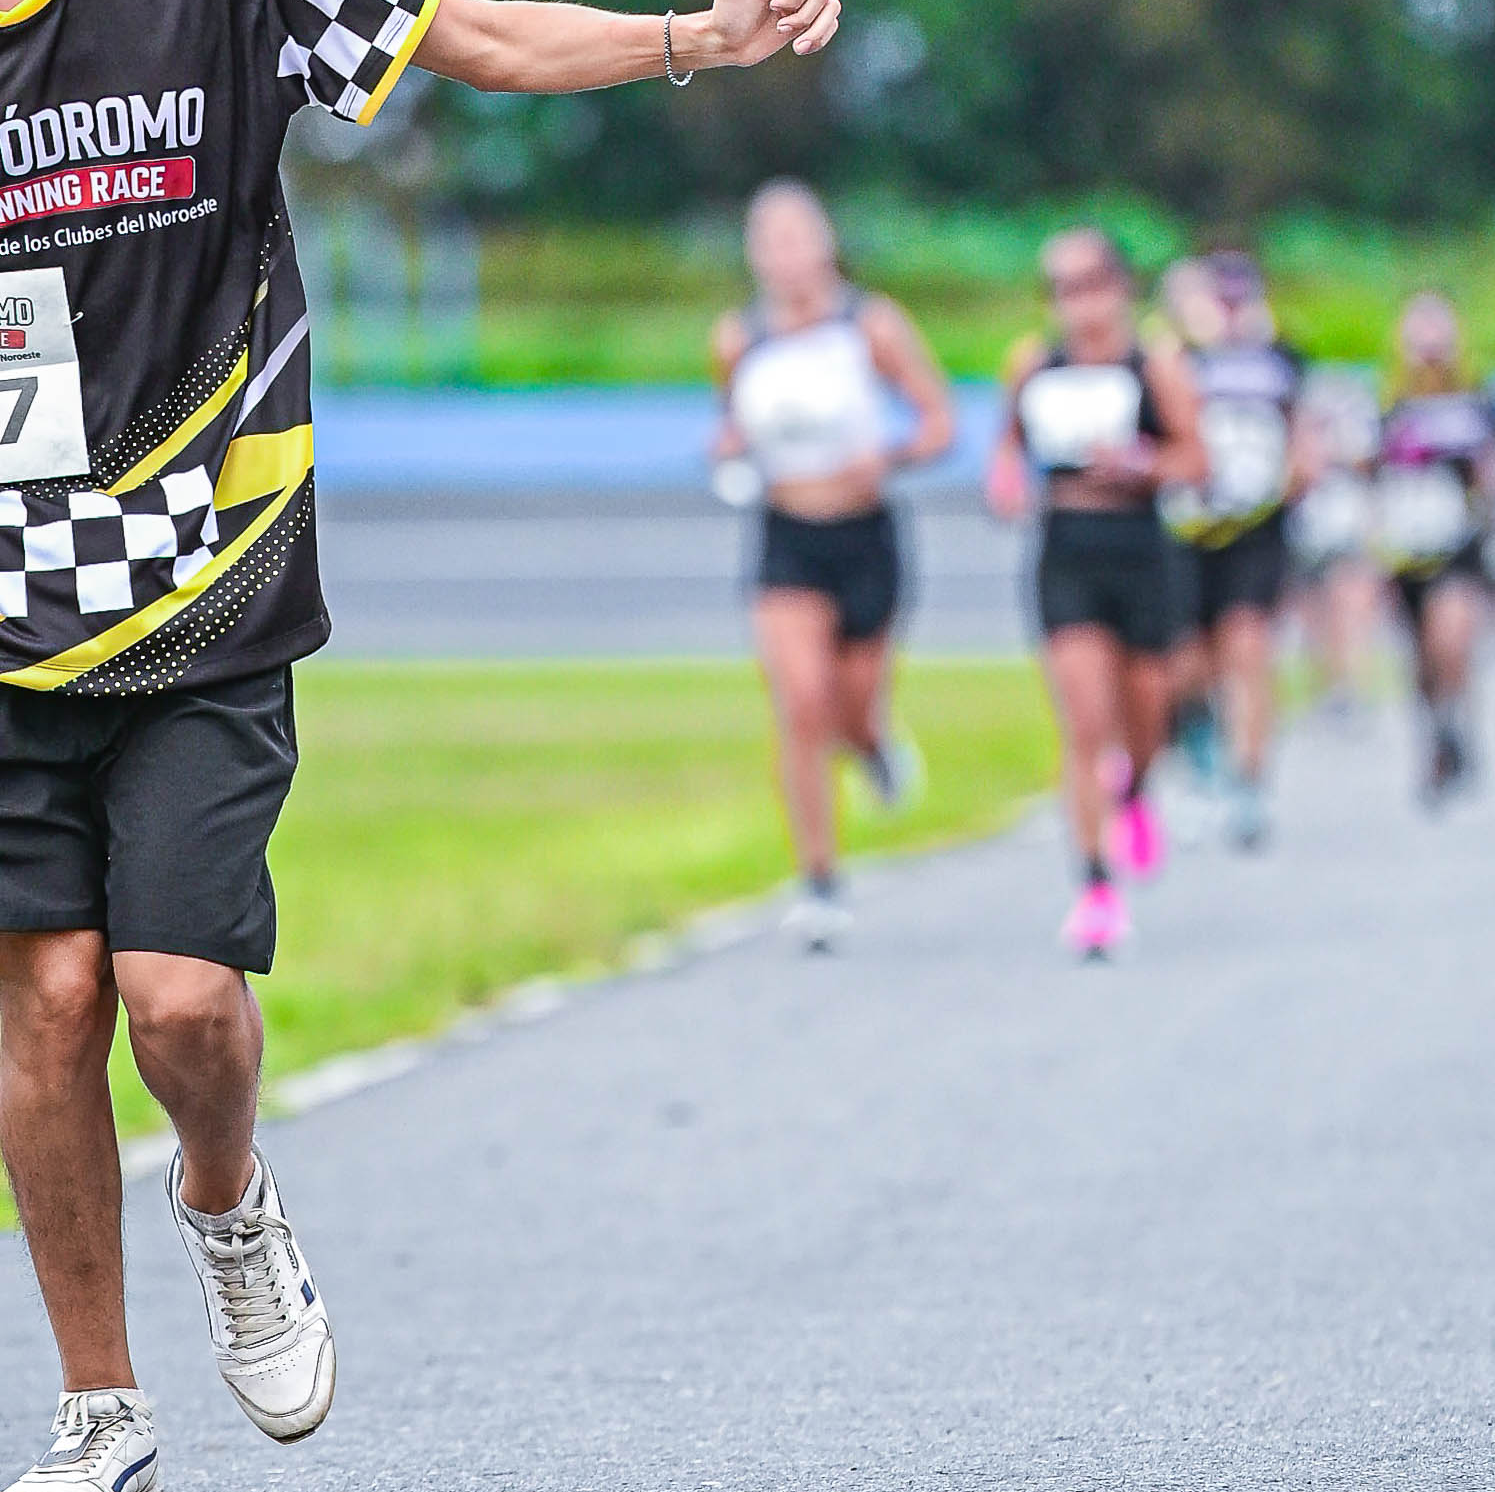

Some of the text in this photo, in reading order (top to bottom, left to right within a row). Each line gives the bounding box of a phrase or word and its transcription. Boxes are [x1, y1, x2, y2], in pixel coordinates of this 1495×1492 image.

[90, 165, 166, 204] RACE
[24, 234, 51, 254] los
[54, 226, 113, 247] Clubes
[117, 215, 145, 234] del
[147, 198, 218, 230] Noroeste
[0, 351, 41, 363] Noroeste
